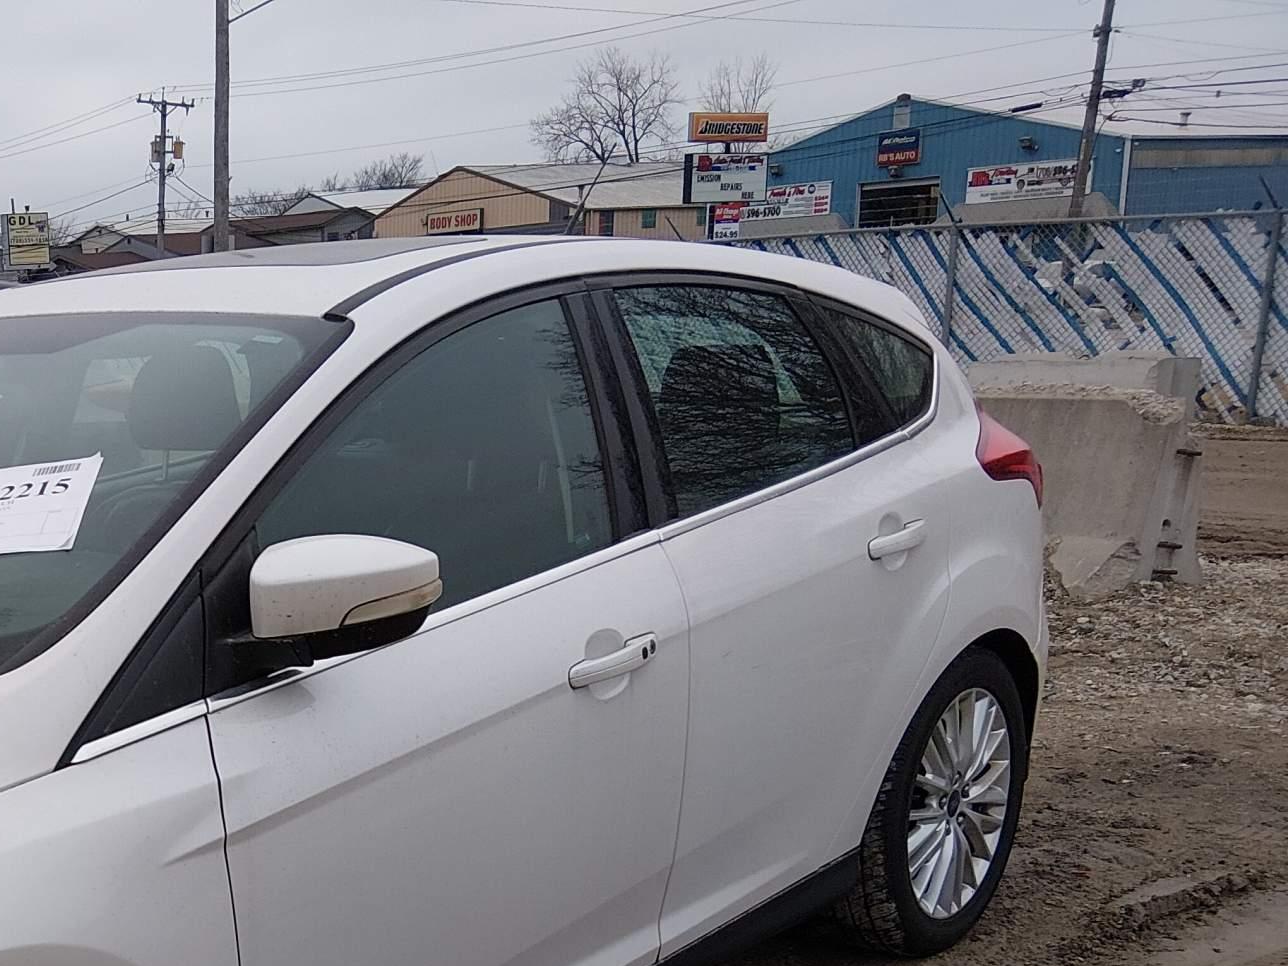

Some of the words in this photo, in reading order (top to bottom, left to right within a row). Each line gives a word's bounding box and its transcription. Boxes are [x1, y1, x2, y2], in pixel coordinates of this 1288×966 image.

[696, 119, 764, 135] BRIDGESTONE
[895, 151, 916, 161] AUTO
[697, 174, 721, 183] EMISSION
[720, 183, 743, 191] REPAIRS
[430, 216, 452, 230] BODY
[455, 213, 478, 227] SHOP
[715, 230, 738, 239] $24.95
